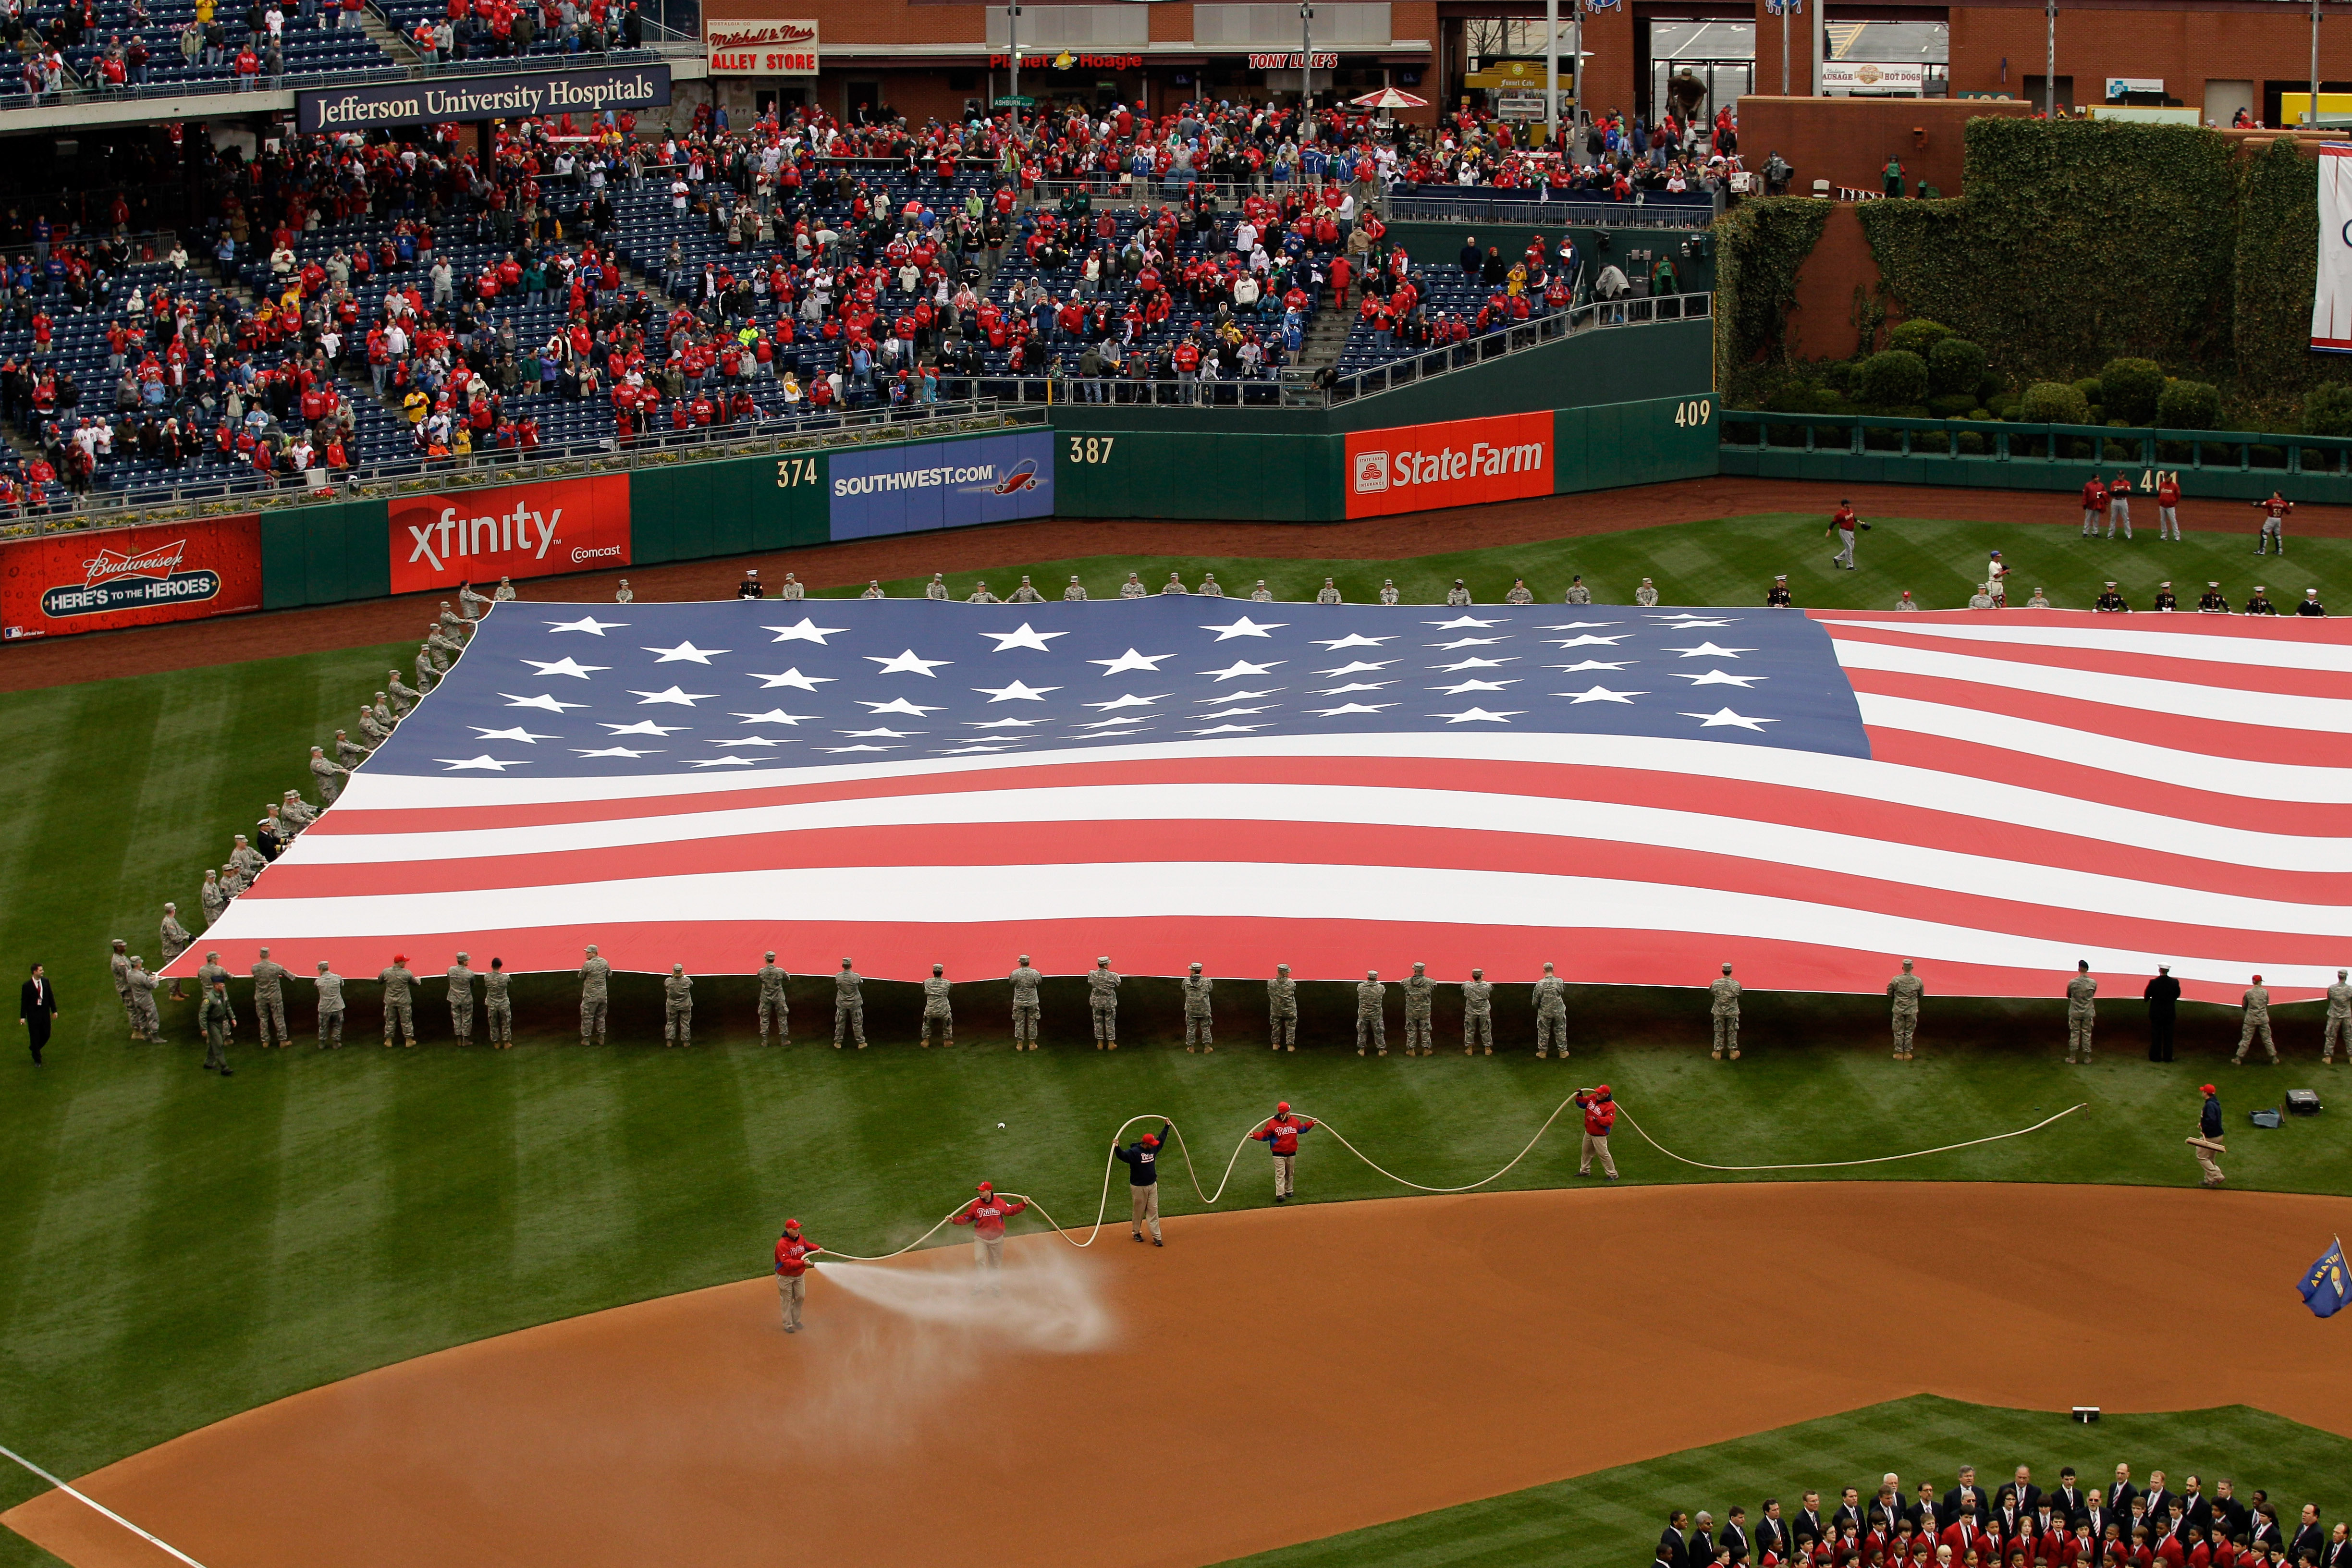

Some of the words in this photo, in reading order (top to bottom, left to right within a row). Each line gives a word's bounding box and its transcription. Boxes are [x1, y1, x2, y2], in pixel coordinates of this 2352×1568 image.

[710, 28, 768, 46] Mitchell
[769, 28, 779, 40] &
[780, 25, 815, 39] Ness
[712, 54, 757, 70] ALLEY
[767, 54, 815, 70] STORE
[1080, 52, 1142, 71] Hoagie
[1249, 53, 1288, 69] TONY
[1289, 53, 1338, 69] LUKE'S
[1500, 79, 1519, 87] Funnel
[318, 96, 420, 129] Jefferson
[425, 86, 542, 114] University
[548, 74, 654, 110] Hospitals
[1675, 399, 1711, 428] 409
[1069, 437, 1115, 464] 387
[777, 458, 818, 488] 374
[1393, 446, 1468, 487] State
[1470, 442, 1543, 478] Farm
[834, 464, 993, 497] SOUTHWEST.COM
[2273, 508, 2282, 517] 55
[408, 500, 563, 572] xfinity
[82, 553, 184, 578] Budweiser
[51, 589, 109, 611] HERE'S
[111, 592, 123, 600] TO
[125, 588, 143, 599] THE
[145, 577, 210, 600] HEROES
